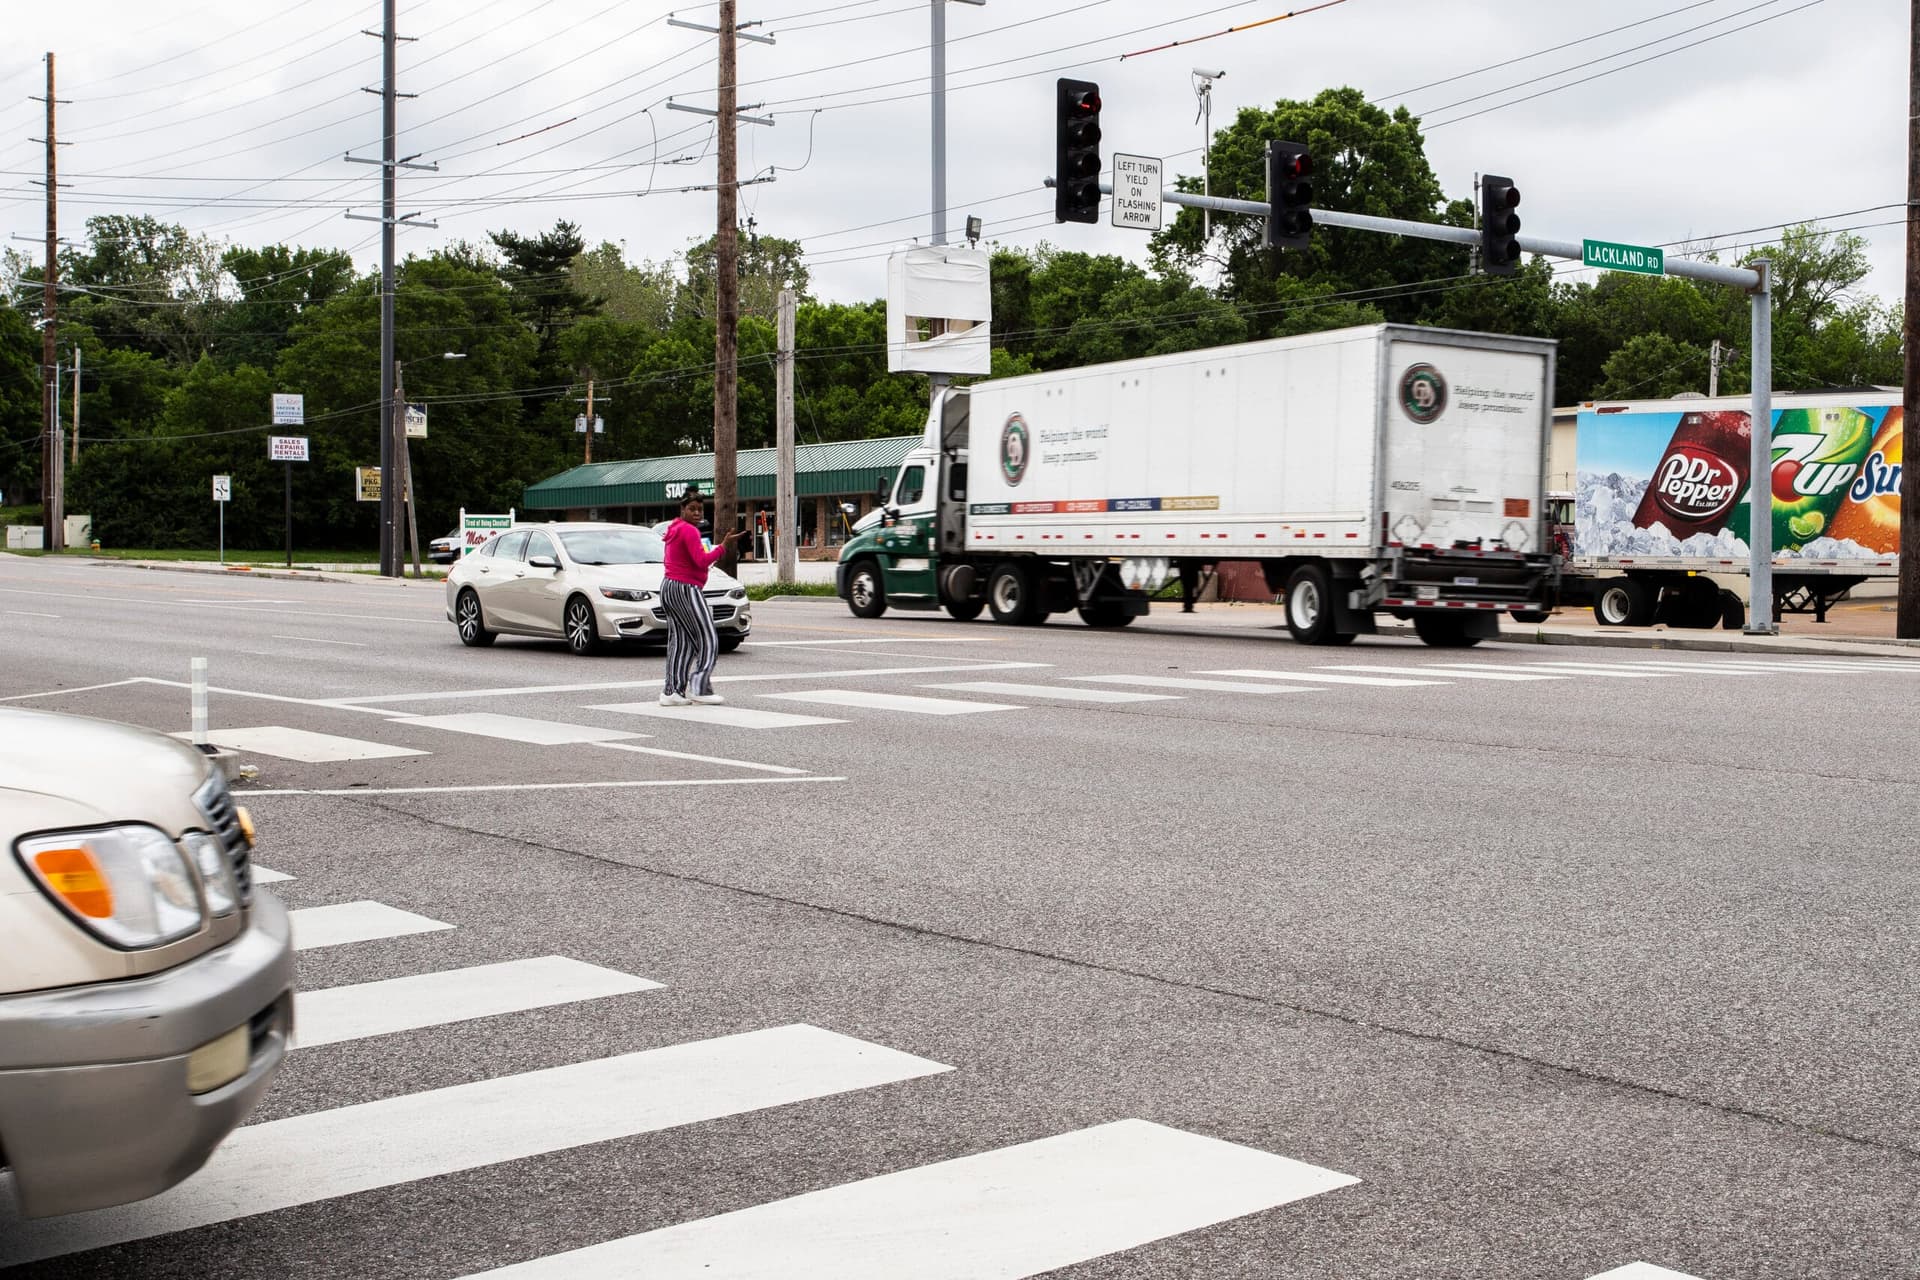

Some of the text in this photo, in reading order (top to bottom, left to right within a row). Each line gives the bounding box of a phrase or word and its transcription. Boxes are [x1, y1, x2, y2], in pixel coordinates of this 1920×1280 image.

[1118, 161, 1158, 175] LEFT TURN
[1126, 174, 1148, 185] YIELD
[1131, 187, 1142, 197] ON
[1118, 198, 1156, 212] FLASHING
[1123, 211, 1151, 224] ARROW
[1588, 245, 1659, 269] LACKLAND RD
[1684, 457, 1721, 484] Dr
[1659, 453, 1733, 506] Pepper
